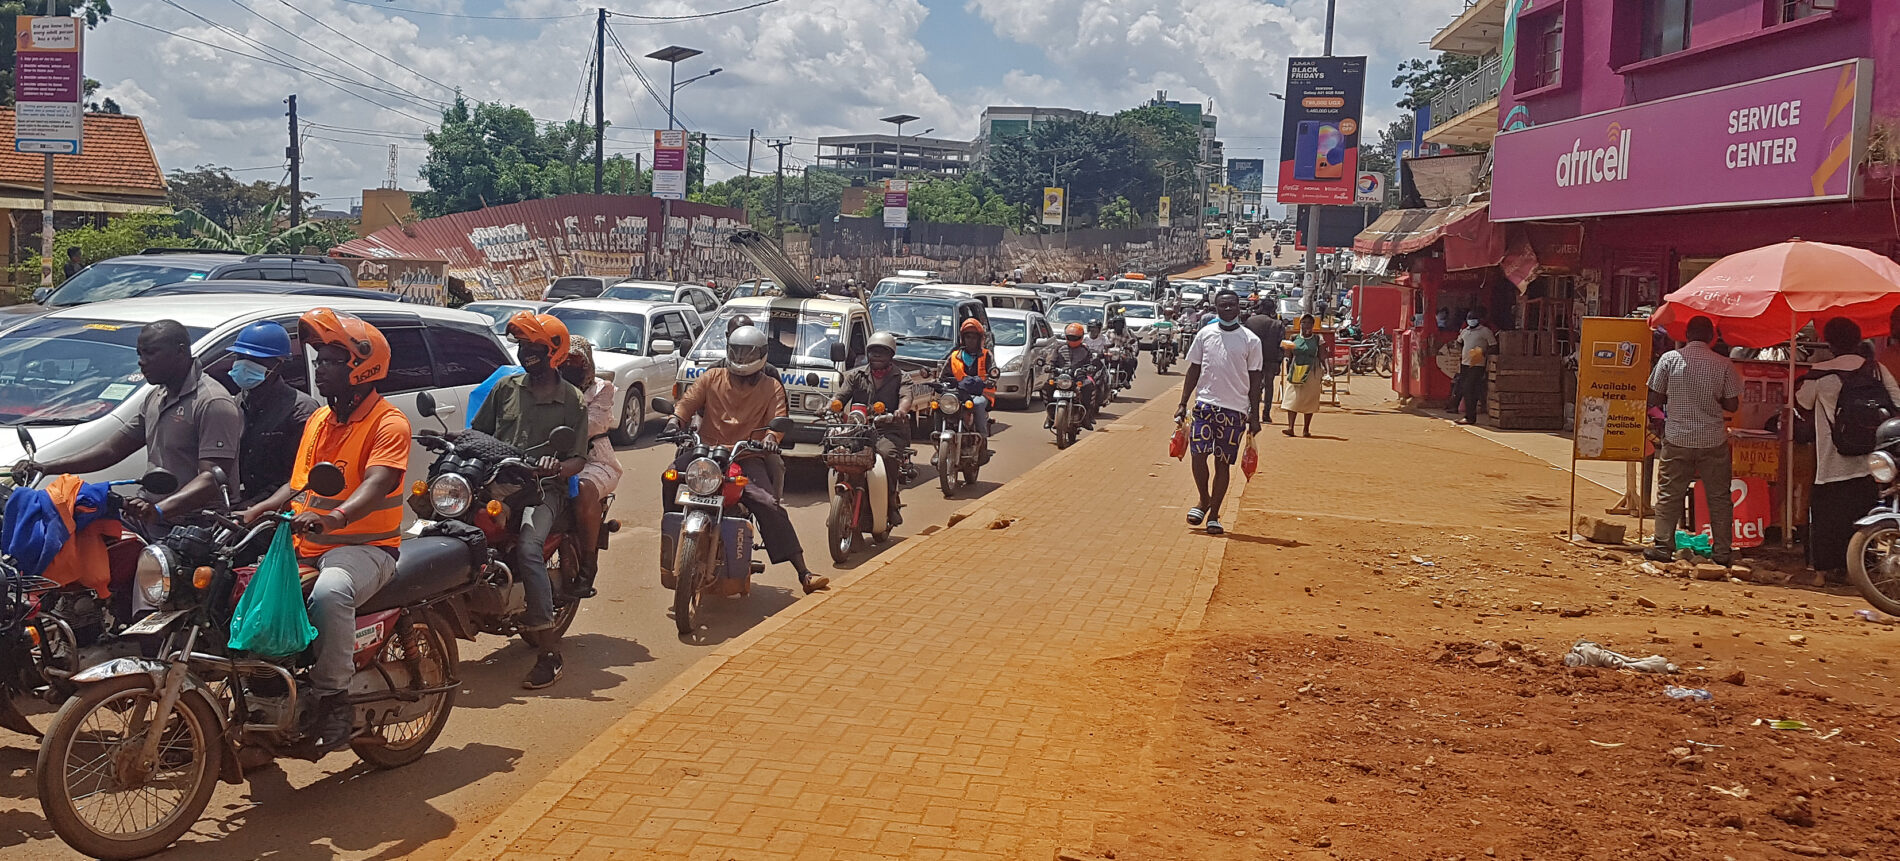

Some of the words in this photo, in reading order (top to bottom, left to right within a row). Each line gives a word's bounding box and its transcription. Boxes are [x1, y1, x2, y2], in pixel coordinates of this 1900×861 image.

[1728, 100, 1801, 135] SERVICE
[1556, 128, 1632, 187] africell
[1725, 137, 1798, 169] CENTER
[781, 372, 830, 389] WAE
[1590, 381, 1637, 392] Available
[1602, 391, 1627, 401] Here
[1607, 414, 1635, 422] Airtime
[1701, 517, 1765, 539] atel
